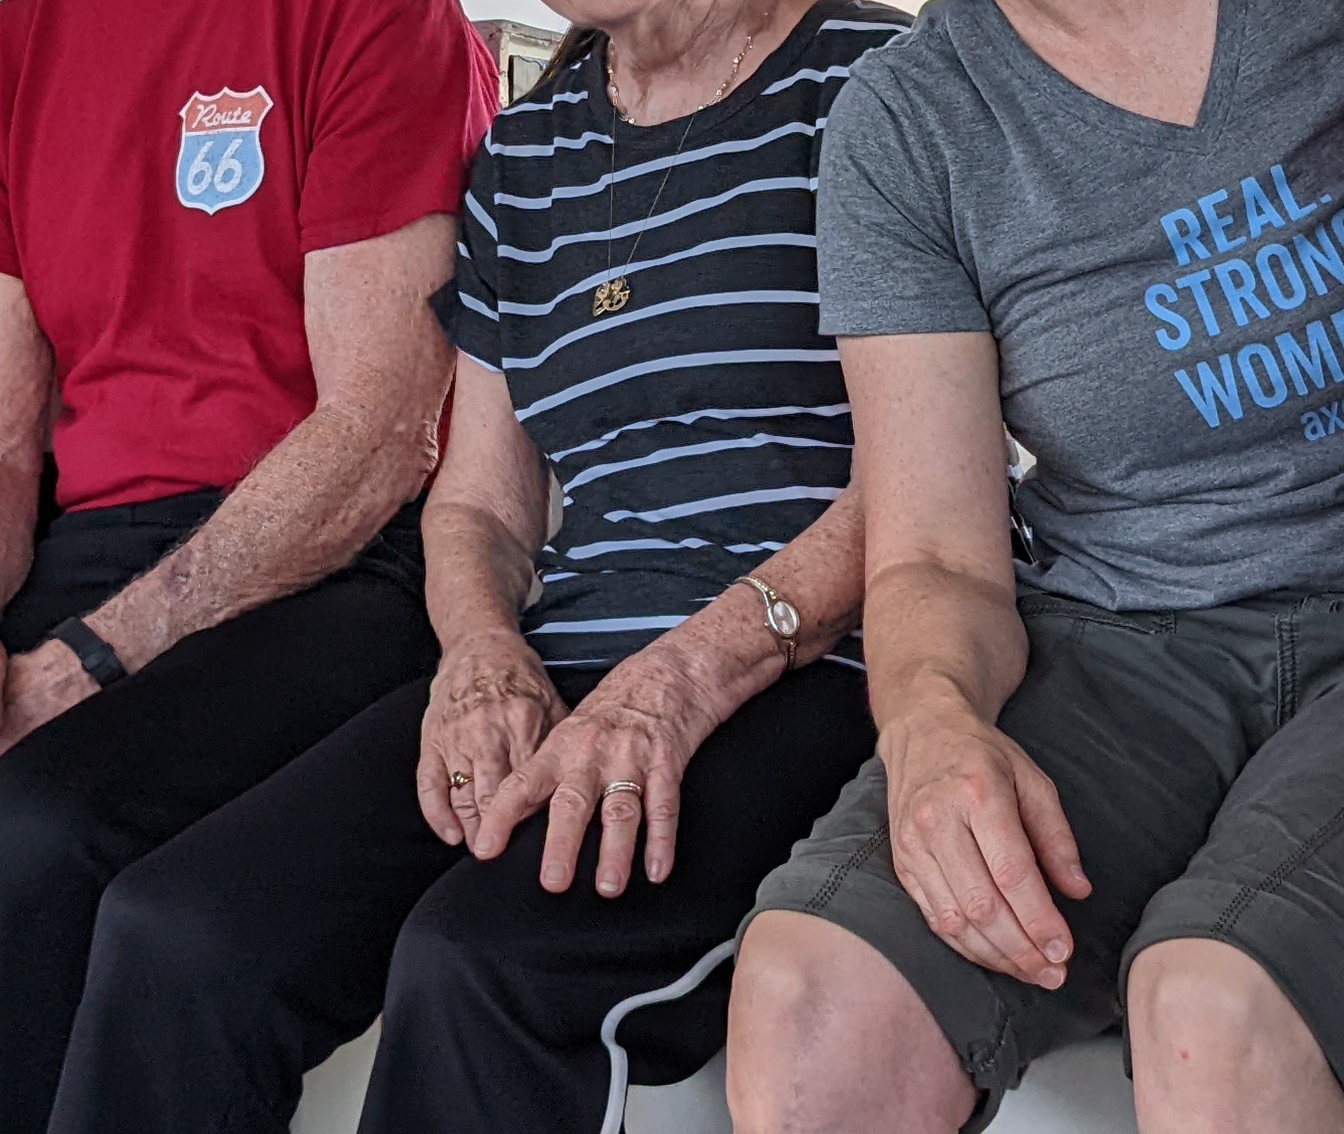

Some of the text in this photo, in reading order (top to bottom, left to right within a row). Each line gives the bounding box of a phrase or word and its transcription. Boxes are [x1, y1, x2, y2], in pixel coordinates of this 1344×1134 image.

[192, 103, 252, 129] Route
[186, 138, 244, 196] 66
[1159, 164, 1332, 266] REAL.
